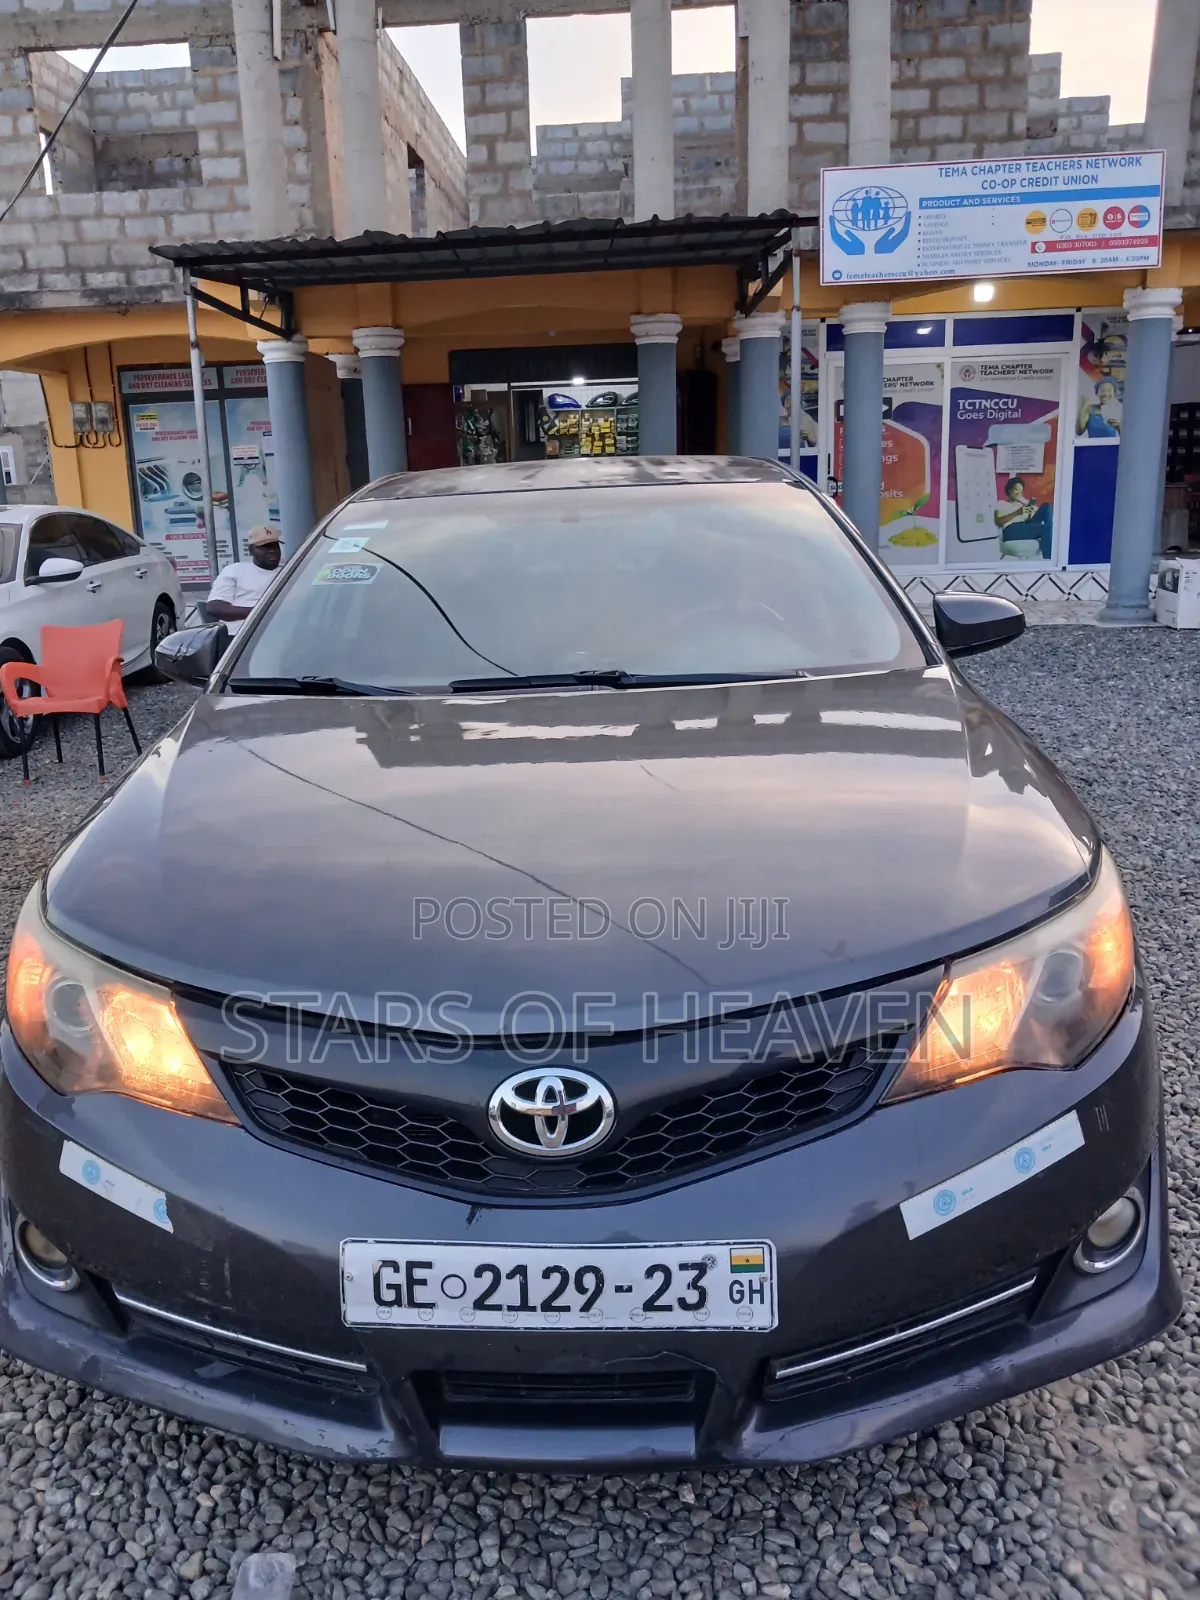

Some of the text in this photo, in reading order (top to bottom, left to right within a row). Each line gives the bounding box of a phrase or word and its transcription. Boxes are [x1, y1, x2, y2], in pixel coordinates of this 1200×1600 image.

[938, 156, 1143, 178] TEMA CHAPTER TEACHERS NETWORK
[981, 174, 1099, 190] CO-OP CREDIT UNION
[922, 196, 1021, 207] PRODUCT AND SERVICES
[957, 398, 1018, 410] TCTNCCU
[957, 408, 1022, 421] Goes Digital
[372, 1259, 437, 1309] GE
[728, 1279, 765, 1305] GH
